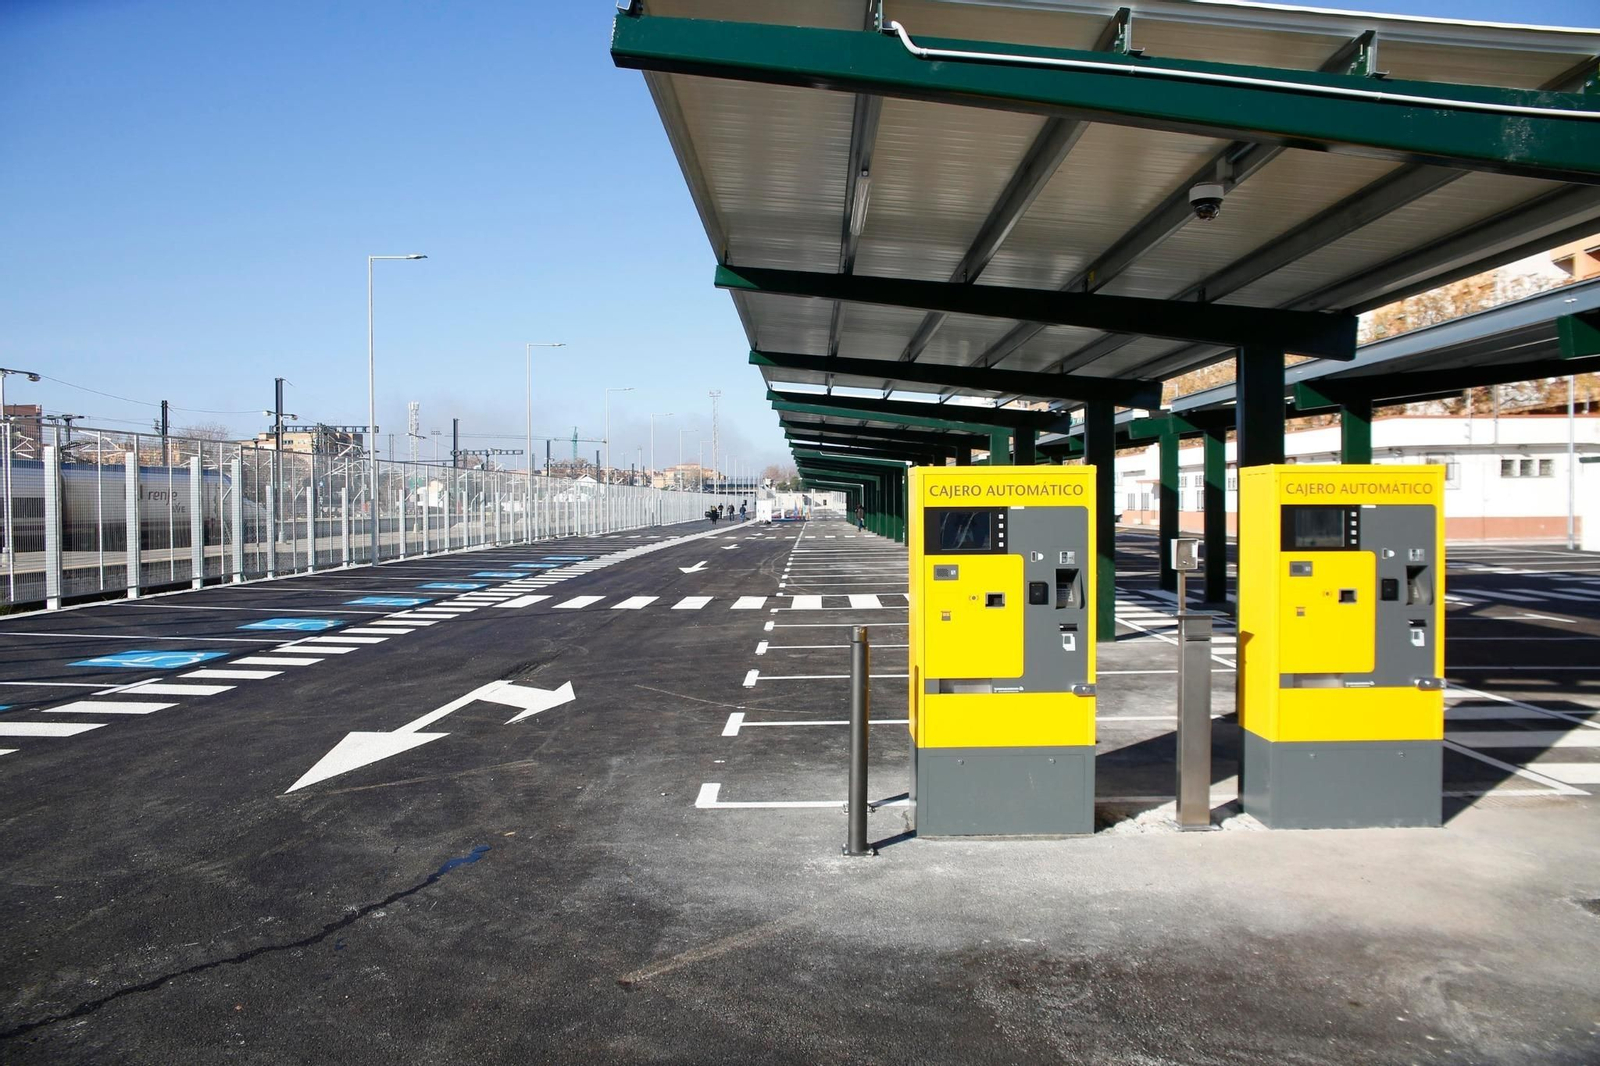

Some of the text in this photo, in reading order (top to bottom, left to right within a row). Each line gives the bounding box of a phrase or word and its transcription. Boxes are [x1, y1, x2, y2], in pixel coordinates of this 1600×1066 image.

[929, 481, 1084, 499] CAJERO AUTOMÁTICO
[1285, 480, 1433, 497] CAJERO AUTOMÁTICO
